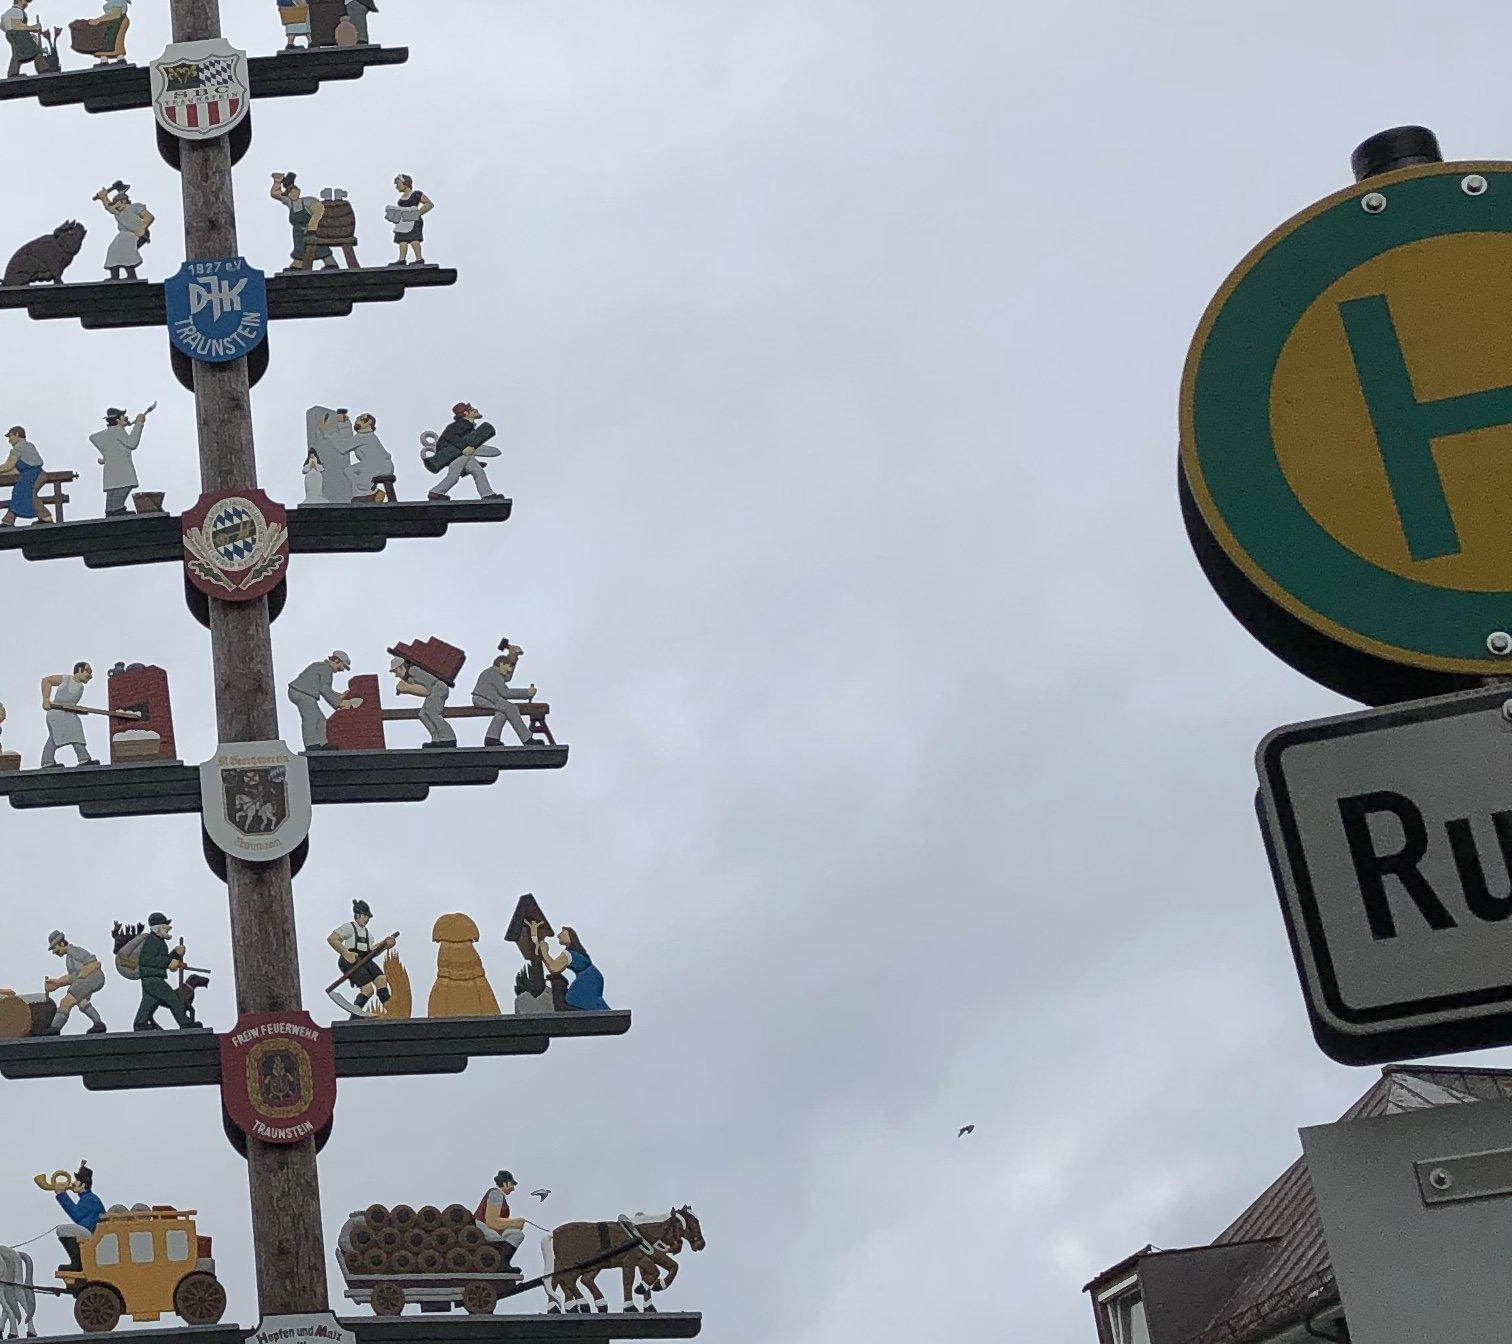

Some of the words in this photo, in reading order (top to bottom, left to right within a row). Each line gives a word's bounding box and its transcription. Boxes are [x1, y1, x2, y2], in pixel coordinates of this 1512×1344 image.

[187, 261, 221, 276] 1927
[174, 311, 261, 357] TRAUNSTEIN
[252, 1119, 314, 1139] TRAUNSTEIN
[296, 1325, 314, 1338] und
[314, 1324, 343, 1342] Malz
